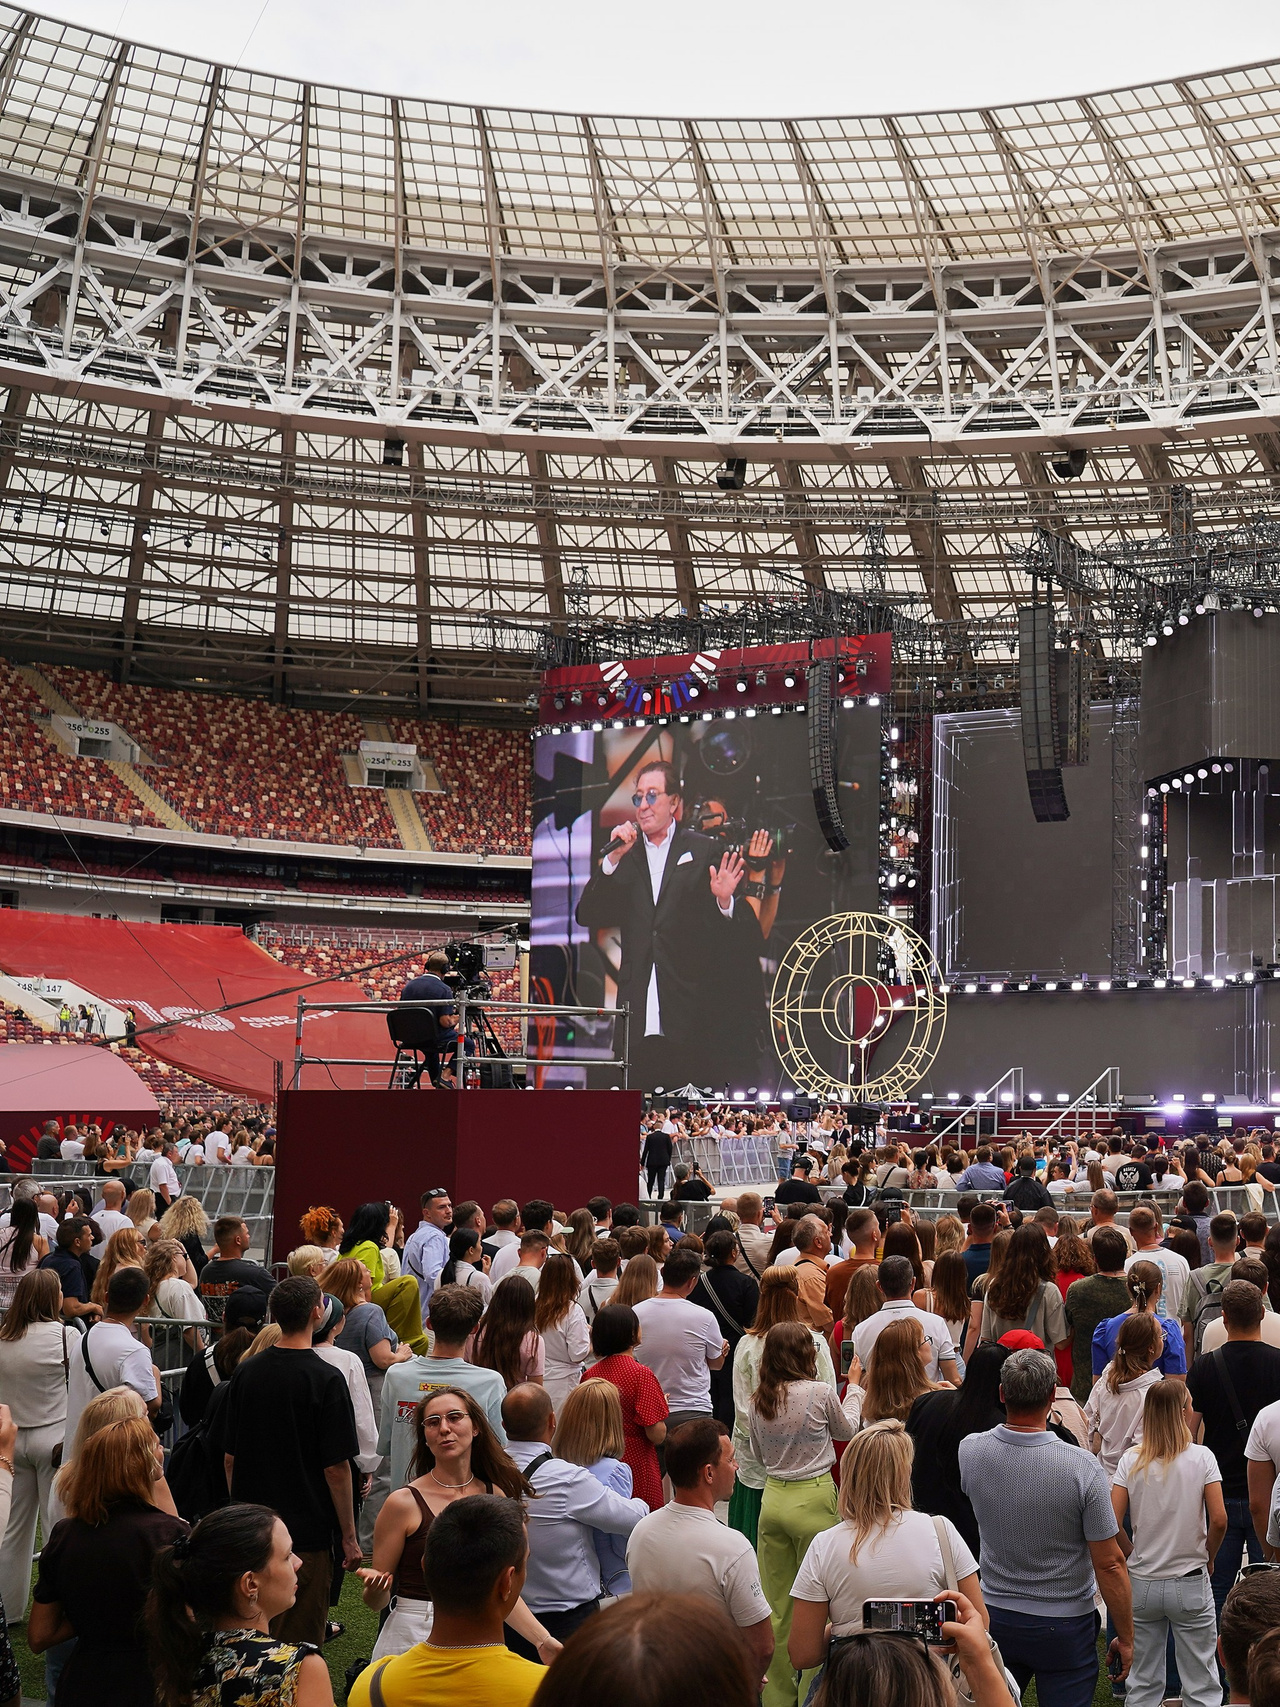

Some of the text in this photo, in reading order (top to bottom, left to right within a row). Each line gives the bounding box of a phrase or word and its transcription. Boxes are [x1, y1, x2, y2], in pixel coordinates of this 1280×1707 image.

[94, 727, 110, 735] 255
[371, 757, 412, 767] 254 253
[46, 985, 62, 993] 147
